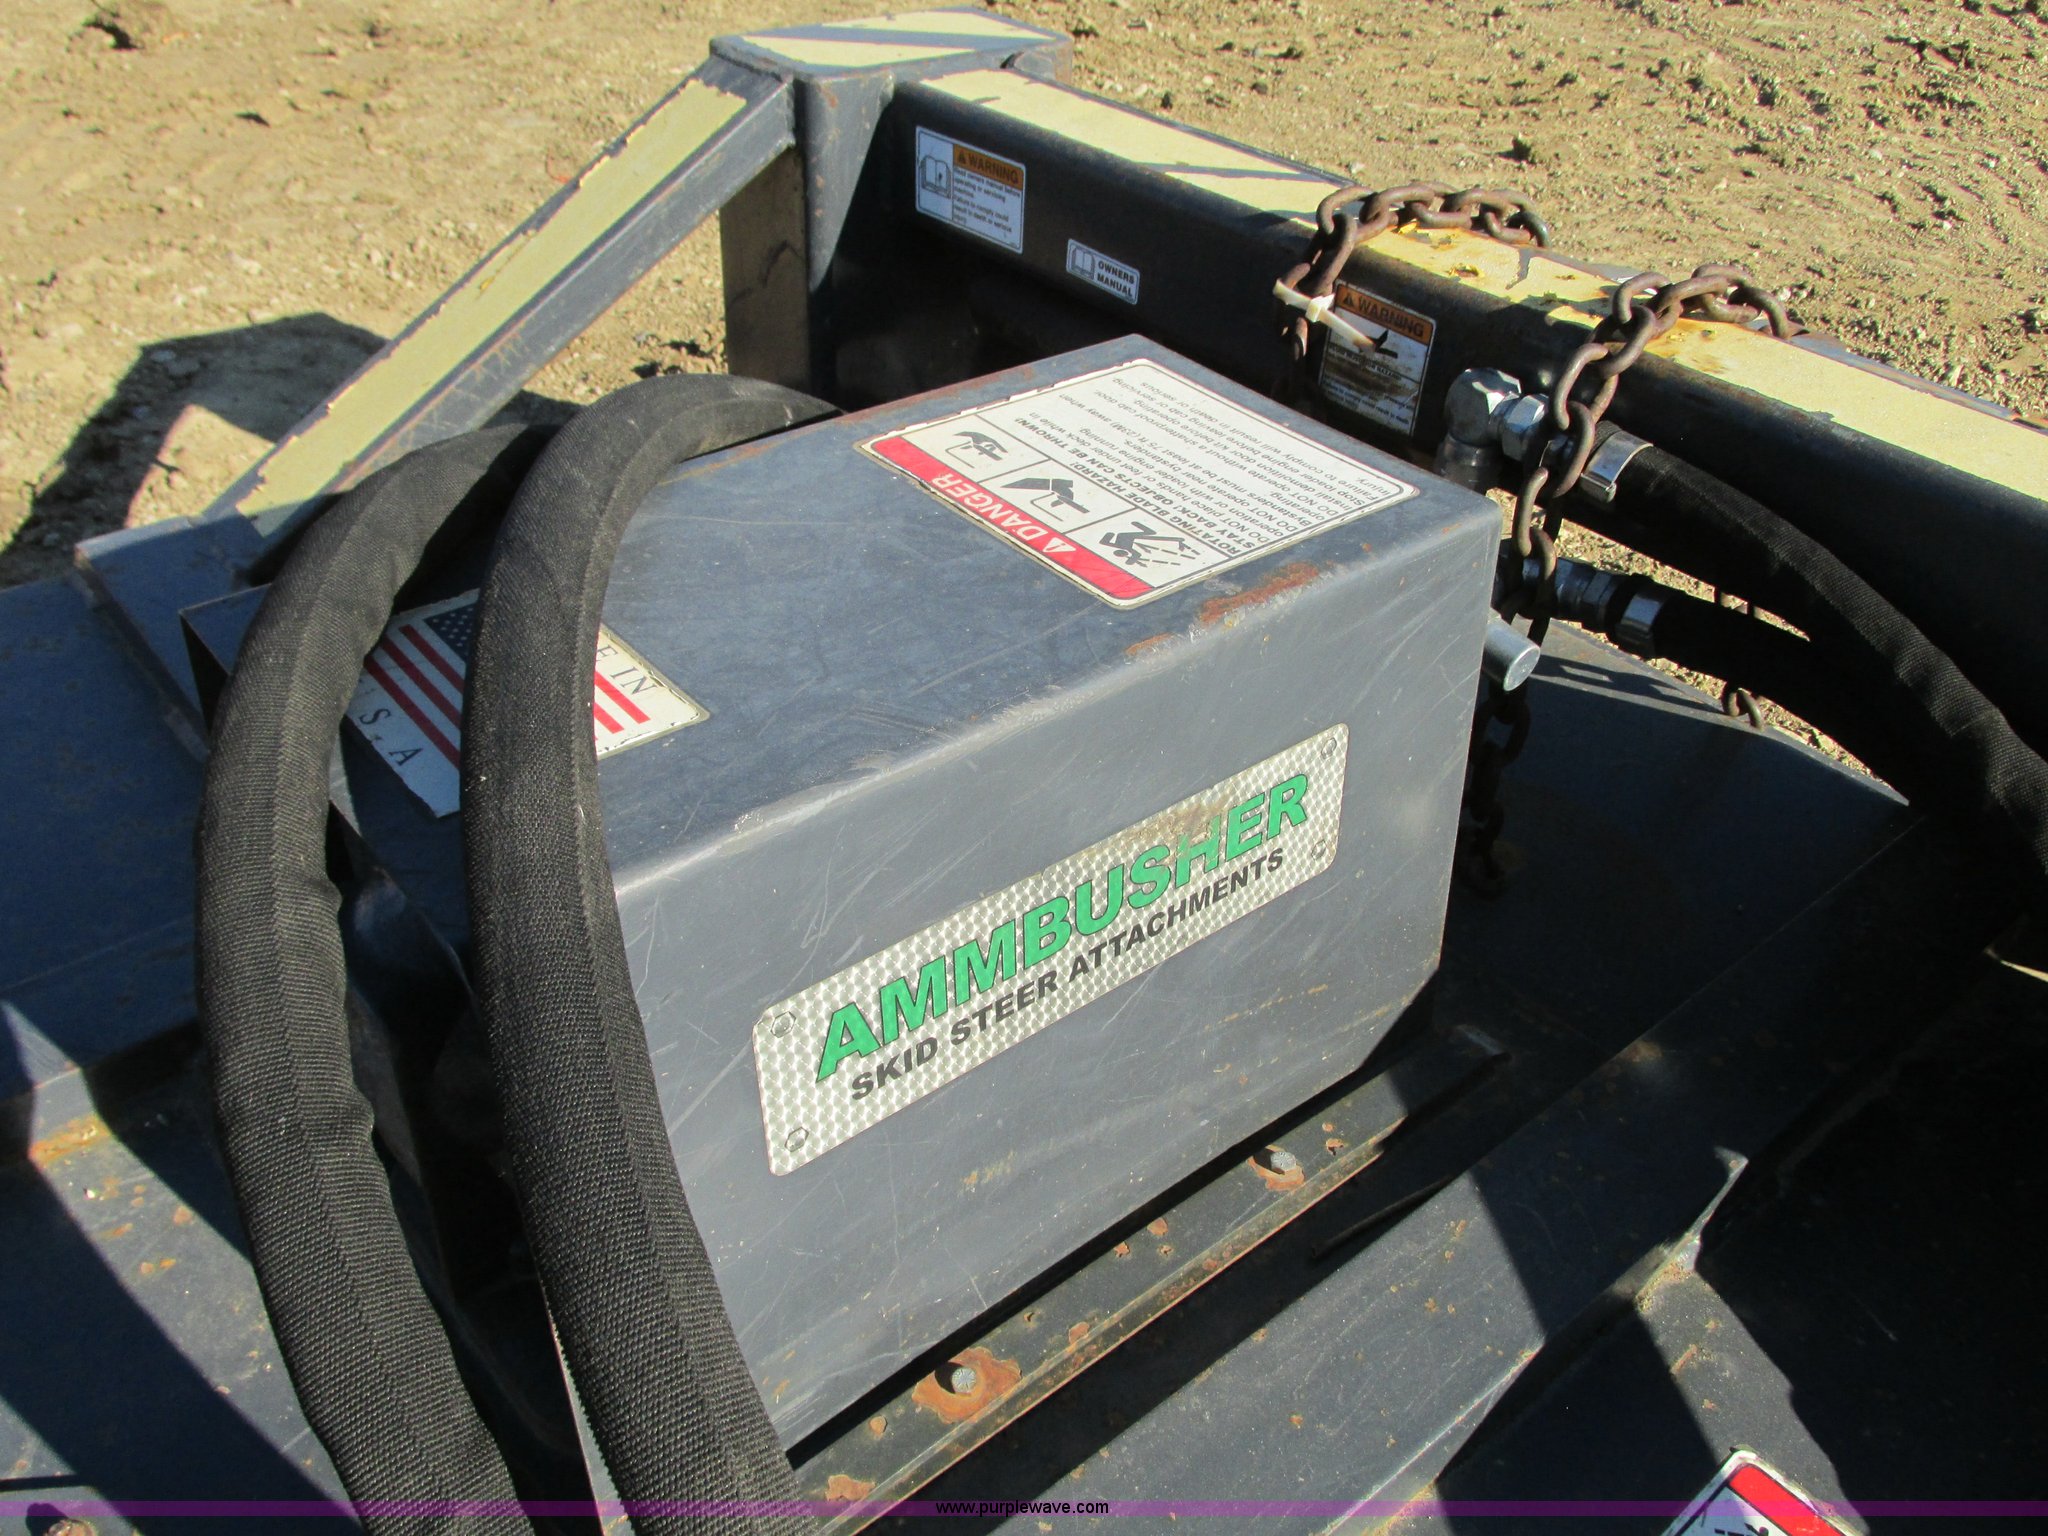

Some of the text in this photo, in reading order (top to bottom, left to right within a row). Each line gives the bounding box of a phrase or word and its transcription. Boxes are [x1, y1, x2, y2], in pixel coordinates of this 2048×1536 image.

[968, 153, 1019, 184] WARNING
[1098, 259, 1134, 284] OWNERS
[1097, 271, 1132, 297] MANUAL
[1357, 296, 1425, 337] WARNING
[1055, 393, 1087, 408] when
[1089, 389, 1119, 403] door.
[1083, 407, 1114, 422] away
[1113, 402, 1138, 414] cab
[1035, 418, 1068, 433] while
[1107, 421, 1143, 438] (23M)
[1133, 412, 1200, 445] shatterproof
[1061, 432, 1092, 447] deck
[1073, 426, 1122, 450] running.
[1145, 441, 1164, 450] 75
[1088, 446, 1123, 464] under
[1115, 449, 1158, 470] engine
[1158, 449, 1190, 464] least
[1203, 449, 1248, 471] without
[1117, 462, 1144, 475] feet
[1198, 469, 1218, 478] be
[1011, 417, 1256, 549] STAY BACK! OBJECTS CAN BE THROWN!
[1117, 438, 1298, 532] DO NOT operate near bystanders.
[1151, 469, 1190, 488] loader
[1214, 477, 1247, 493] must
[1245, 468, 1293, 492] operate
[1153, 481, 1192, 501] hands
[1186, 487, 1215, 501] with
[1288, 491, 1319, 505] NOT
[928, 473, 1050, 540] DANGER
[1068, 461, 1241, 555] ROTATING BLADE HAZARD!
[1187, 499, 1225, 517] place
[1244, 491, 1314, 526] Bystanders
[1315, 504, 1339, 515] DO
[1219, 516, 1250, 532] NOT
[1225, 506, 1286, 537] operation
[1246, 530, 1271, 543] DO
[610, 666, 658, 695] IN
[815, 773, 1309, 1083] AMMBUSHER
[852, 847, 1284, 1100] SKID STEER ATTACHMENTS
